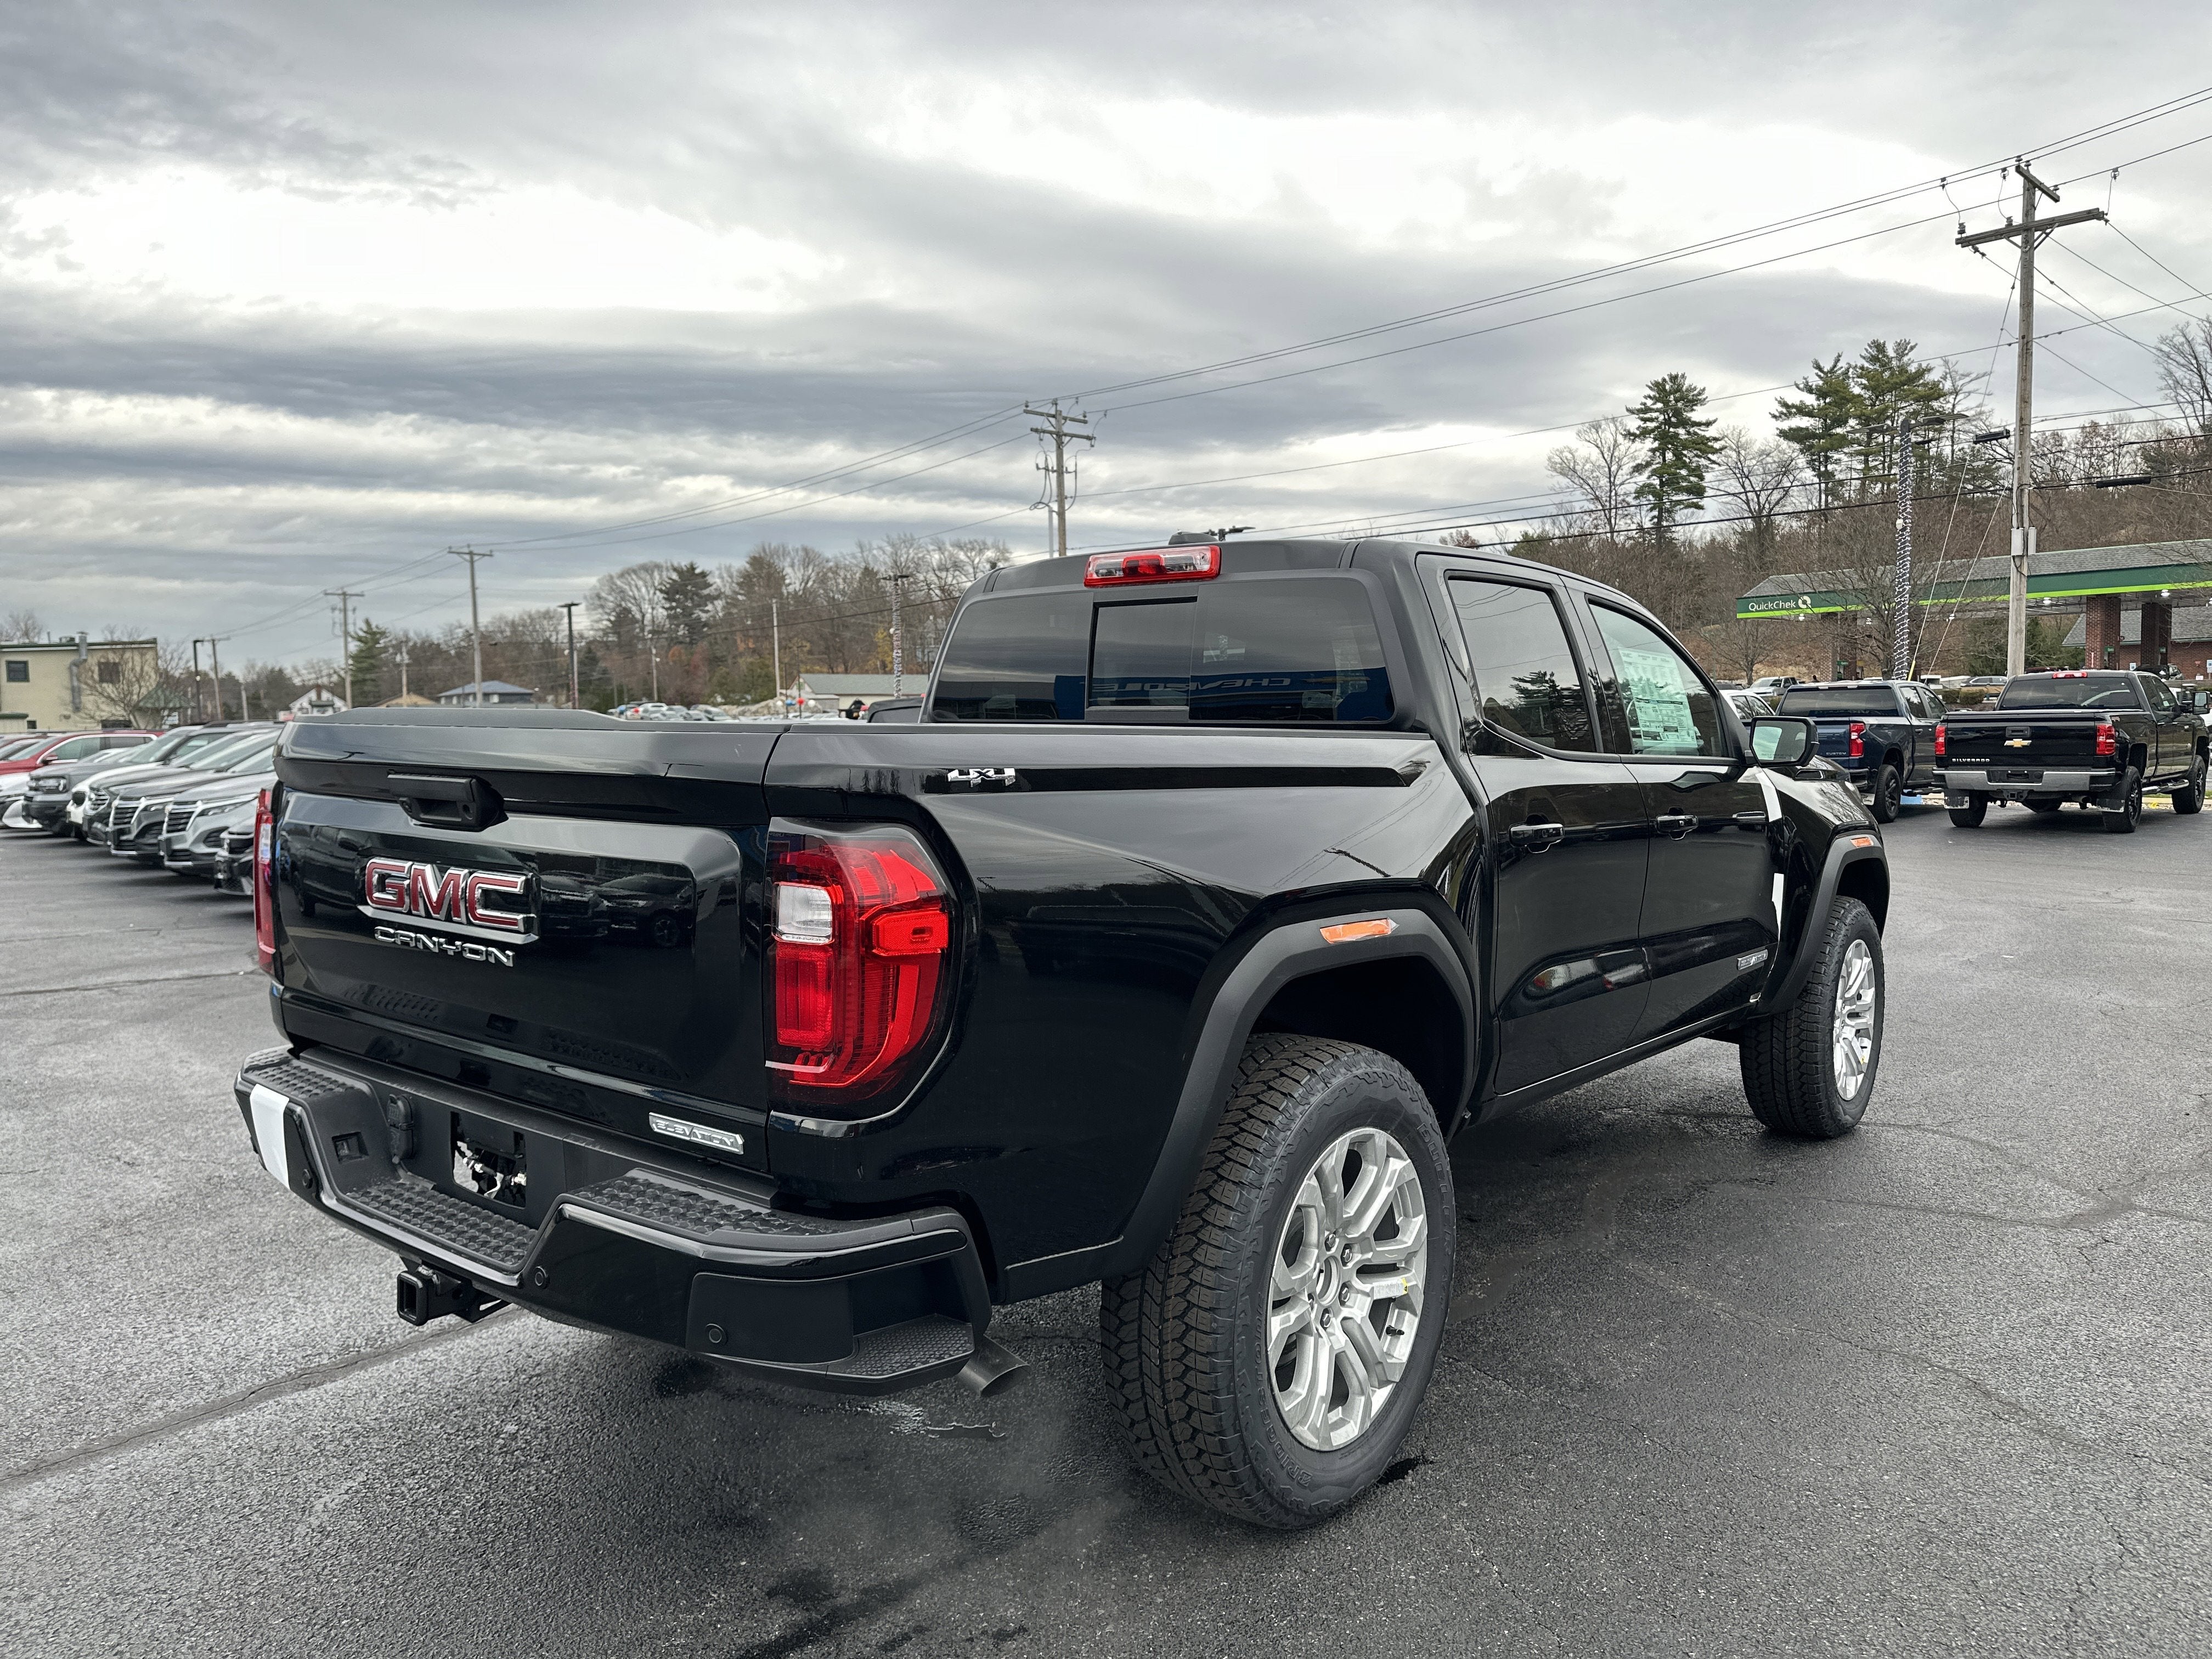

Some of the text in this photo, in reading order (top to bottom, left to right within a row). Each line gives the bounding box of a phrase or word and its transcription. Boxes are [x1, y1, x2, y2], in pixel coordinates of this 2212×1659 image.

[1748, 600, 1797, 612] QuickChek
[365, 857, 534, 933] GMC
[374, 926, 515, 967] CANYON
[655, 1119, 734, 1147] ELEVATION
[1417, 1123, 1452, 1256] DUELER
[1254, 1298, 1313, 1487] BRIDGESTONE
